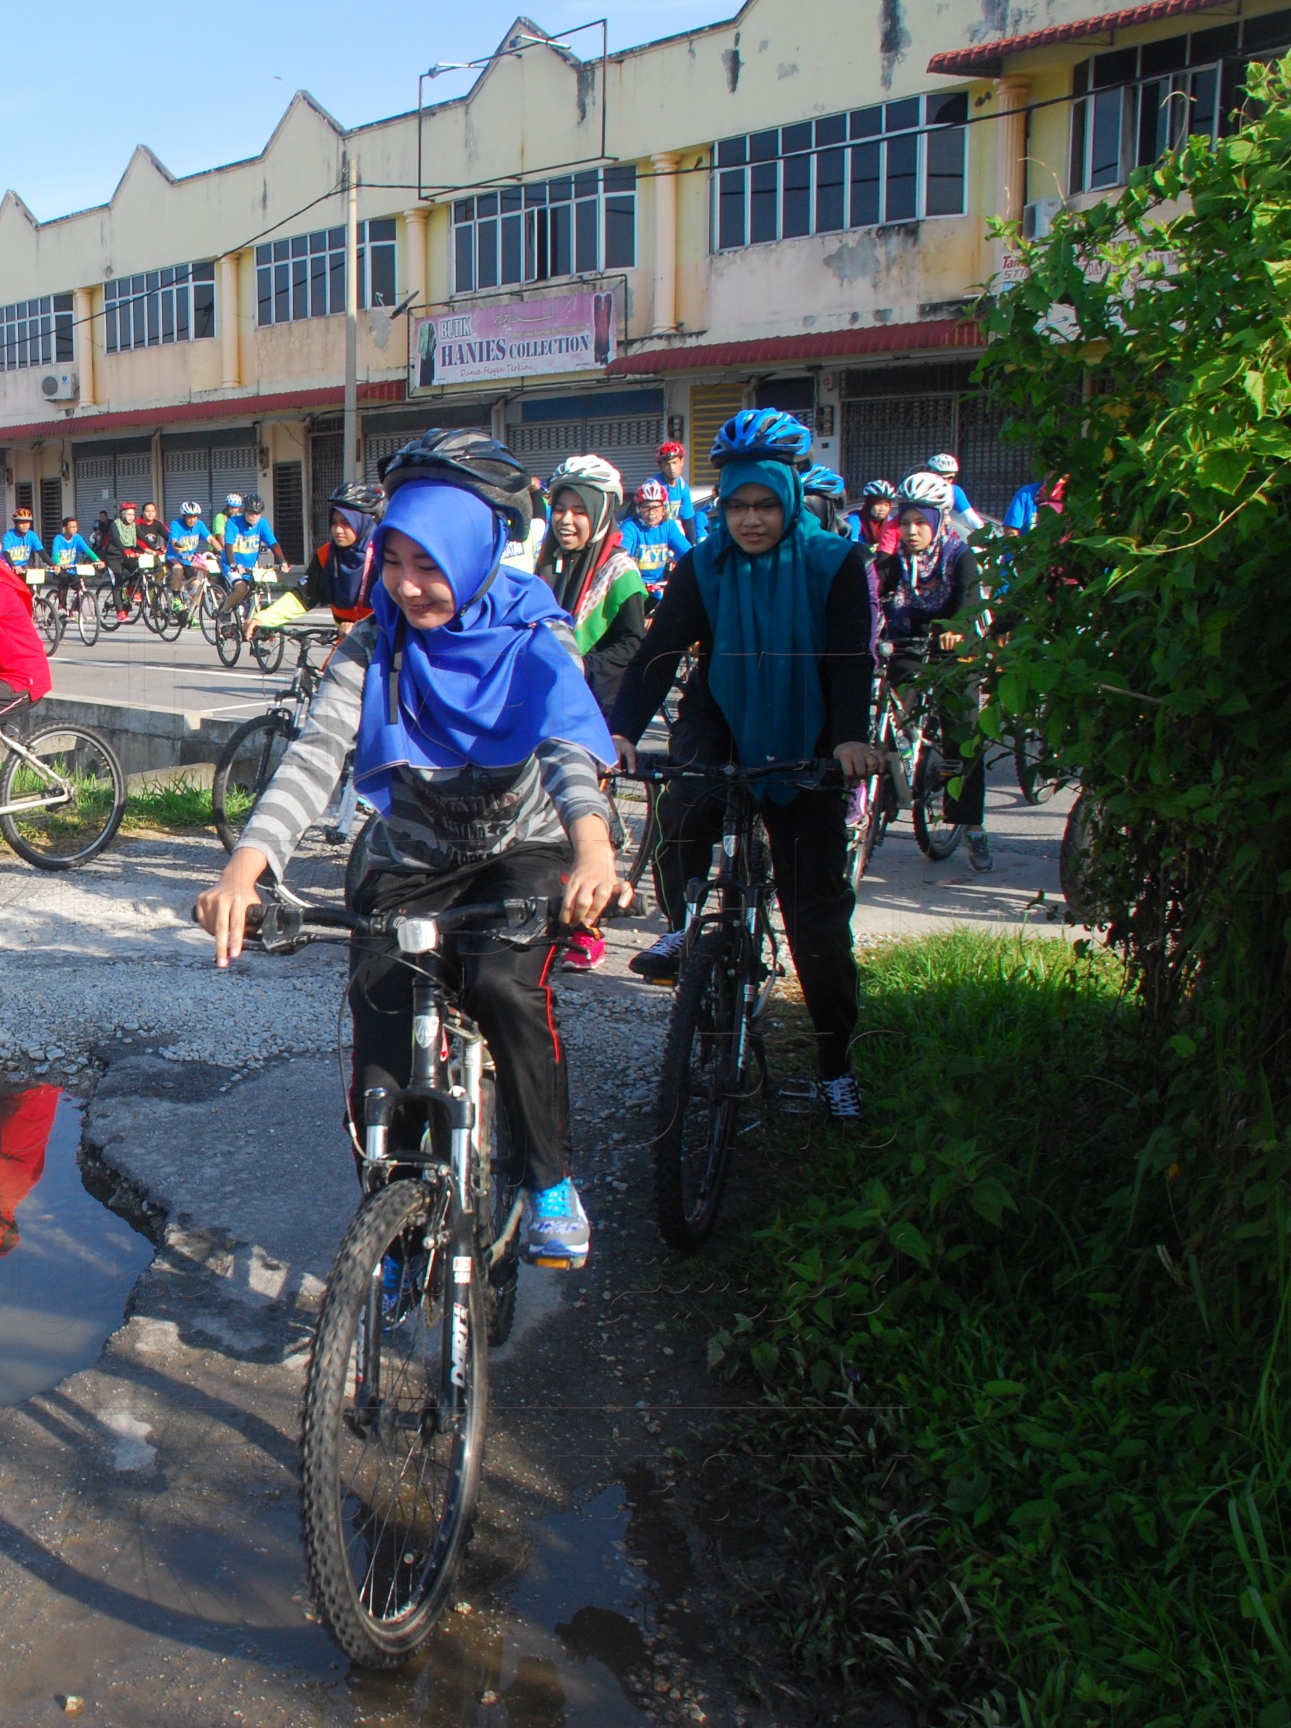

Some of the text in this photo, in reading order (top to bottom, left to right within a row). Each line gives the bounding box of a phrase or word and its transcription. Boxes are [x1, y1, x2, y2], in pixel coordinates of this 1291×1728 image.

[441, 316, 471, 339] BUTIK
[441, 335, 589, 367] HANIES COLLECTION
[507, 360, 534, 372] Terkini
